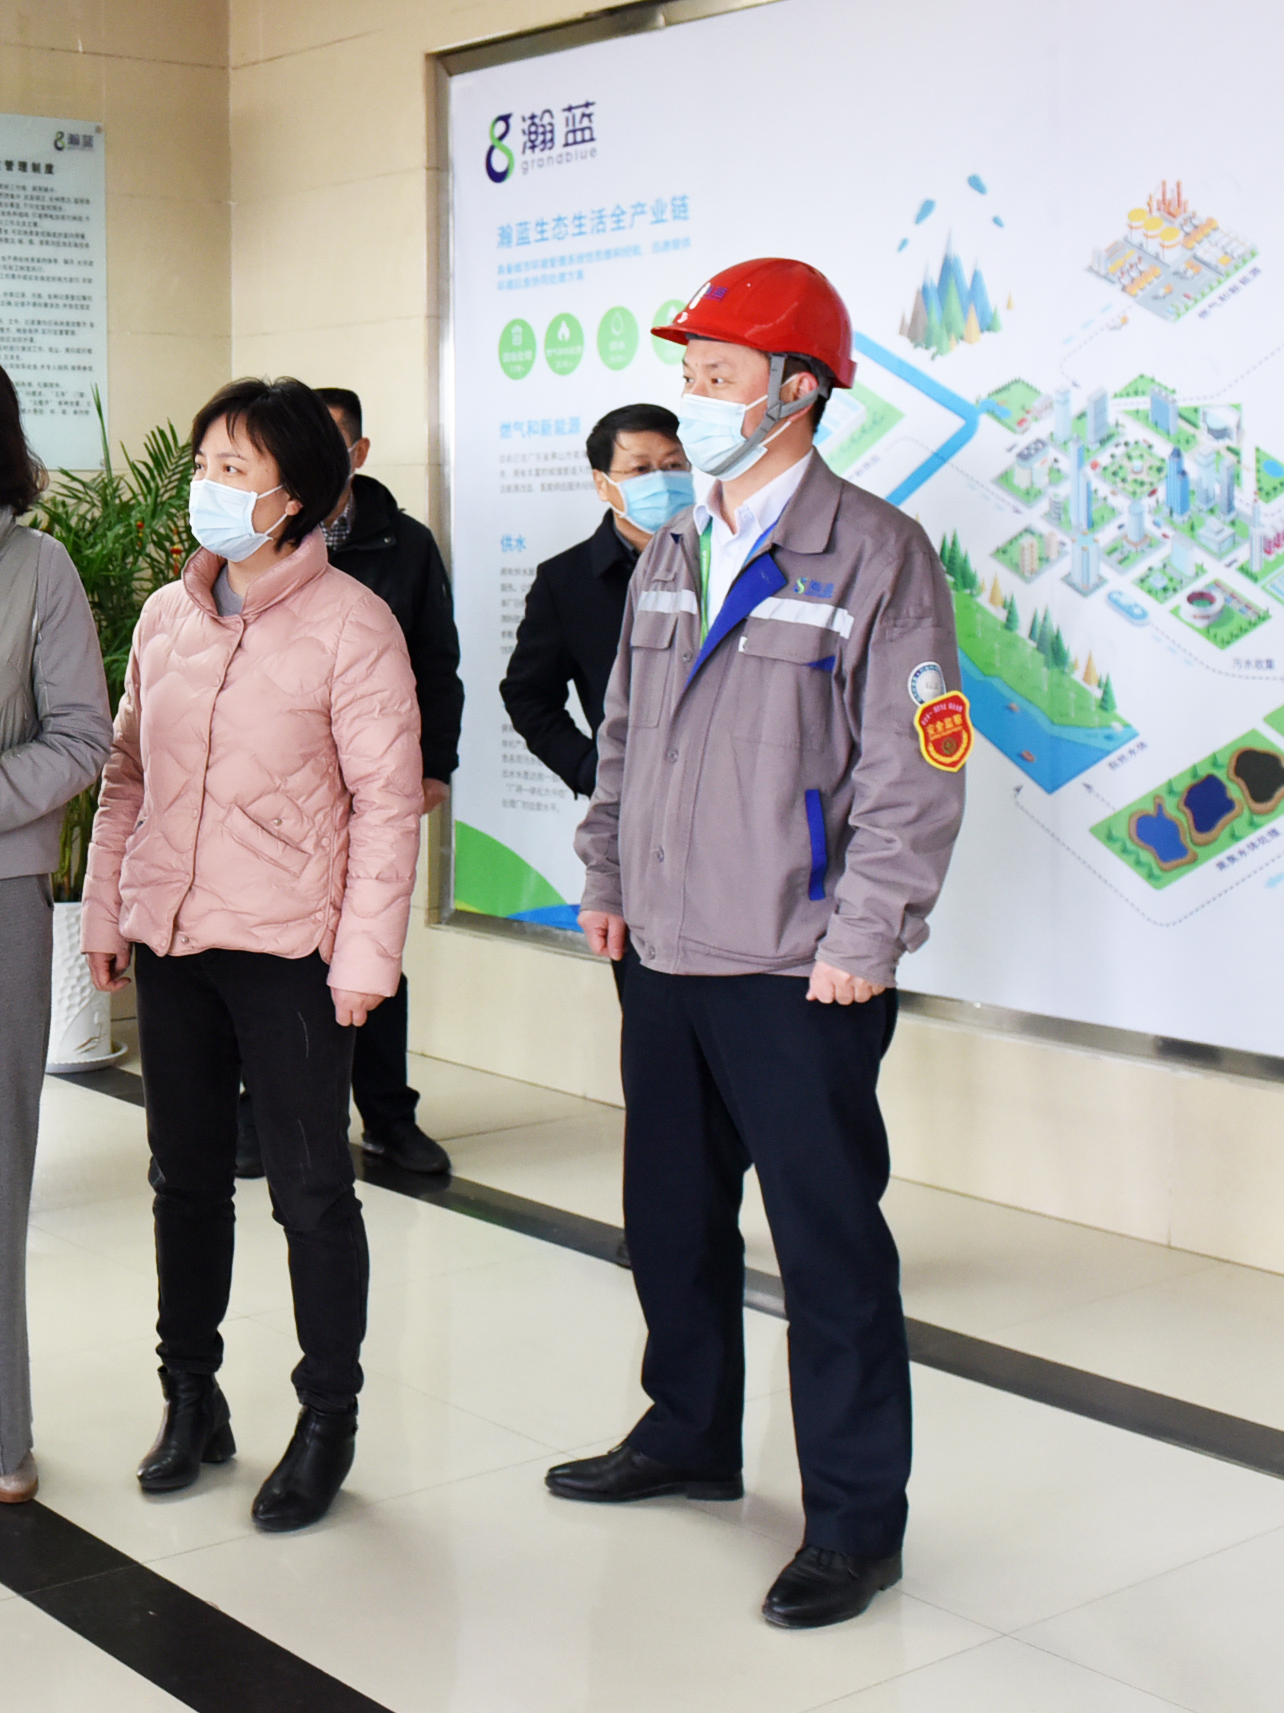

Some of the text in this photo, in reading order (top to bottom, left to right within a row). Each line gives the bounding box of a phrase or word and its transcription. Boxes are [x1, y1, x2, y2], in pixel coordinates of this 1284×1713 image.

[521, 100, 596, 155] 瀚蓝
[497, 194, 690, 249] 瀚蓝生态生活全产业链
[501, 534, 526, 552] 供水
[1232, 658, 1276, 671] 污水收集
